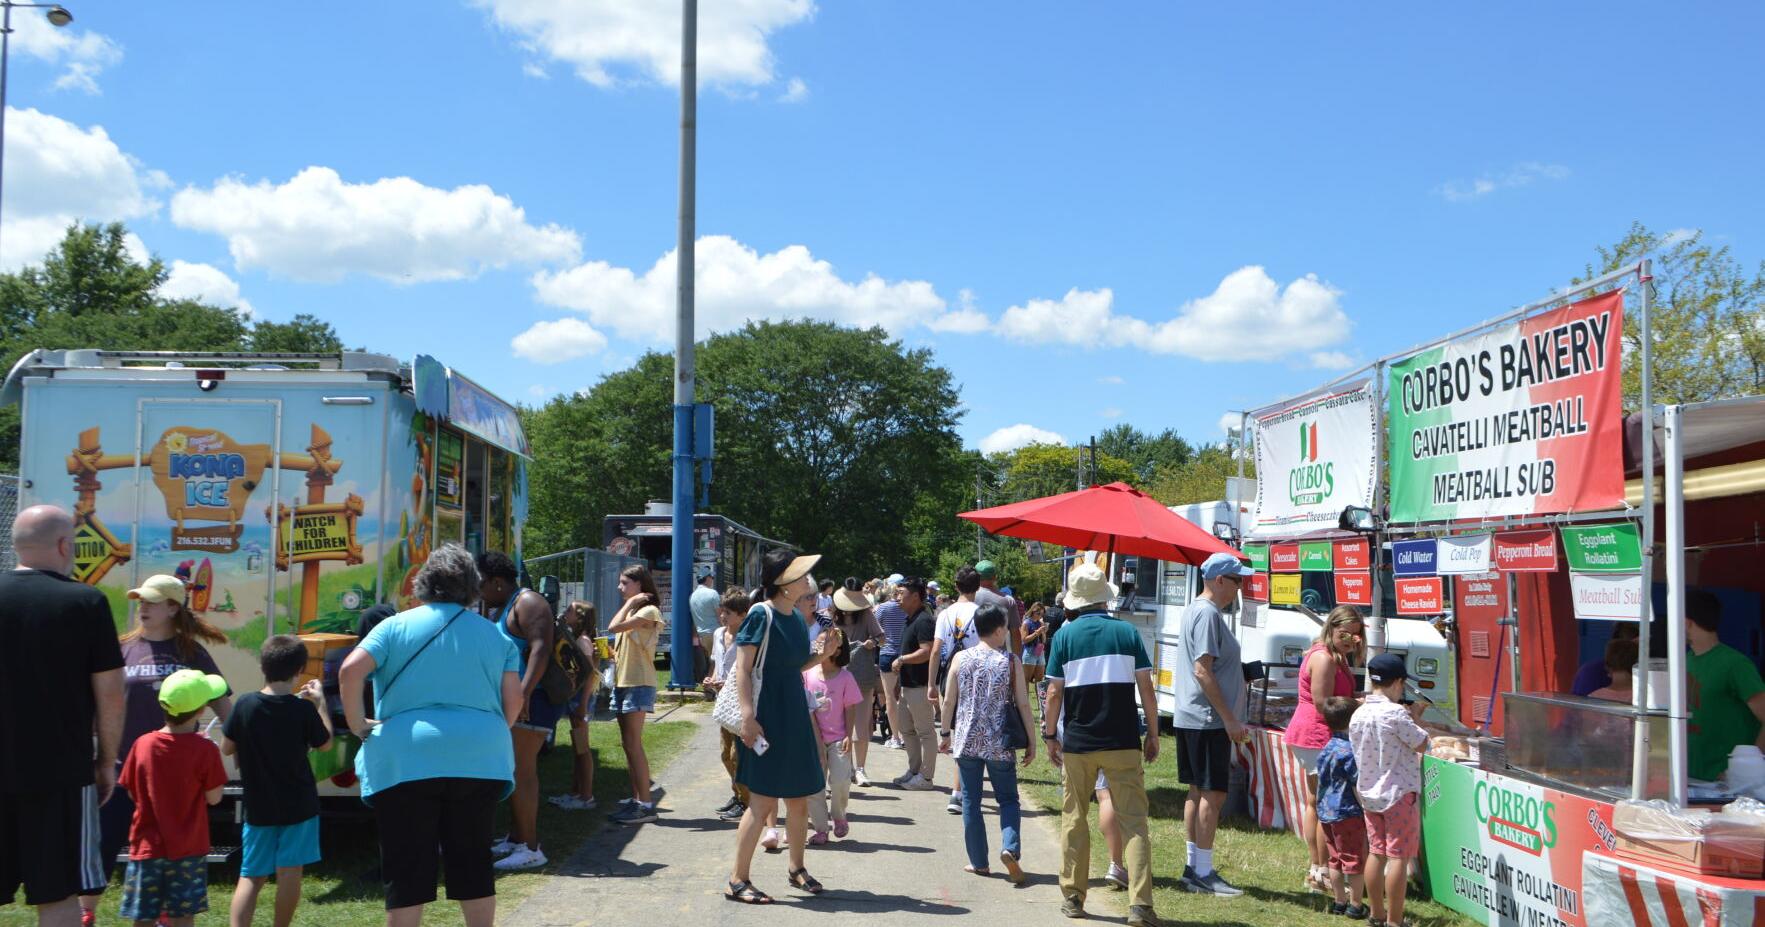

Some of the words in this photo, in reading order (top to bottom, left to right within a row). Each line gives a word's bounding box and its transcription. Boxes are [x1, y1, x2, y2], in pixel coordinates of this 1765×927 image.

[1402, 349, 1494, 415] CORBO'S
[1500, 313, 1610, 392] BAKERY
[1413, 417, 1488, 459] CAVATELLI
[1493, 397, 1587, 445] MEATBALL
[169, 453, 245, 480] KONA
[1433, 466, 1512, 505] MEATBALL
[1516, 460, 1554, 496] SUB
[185, 481, 230, 507] ICE
[303, 527, 326, 539] FOR
[1578, 532, 1617, 549] Eggplant
[74, 541, 105, 559] UTION
[1398, 552, 1412, 564] Cold
[1413, 551, 1434, 564] Water
[1450, 548, 1467, 561] Cold
[1468, 547, 1482, 563] Pop
[1497, 543, 1533, 562] Pepperoni
[1534, 541, 1554, 558] Bread
[1584, 552, 1619, 564] Rollatini
[1403, 584, 1433, 593] Homemade
[1578, 587, 1621, 605] Meatball
[1401, 600, 1420, 608] Cheese
[124, 664, 193, 677] WHISK
[1474, 780, 1558, 849] CORBO'S
[1494, 823, 1536, 850] BAKERY
[1461, 847, 1514, 887] EGGPLANT
[1517, 870, 1577, 915] ROLLATINI
